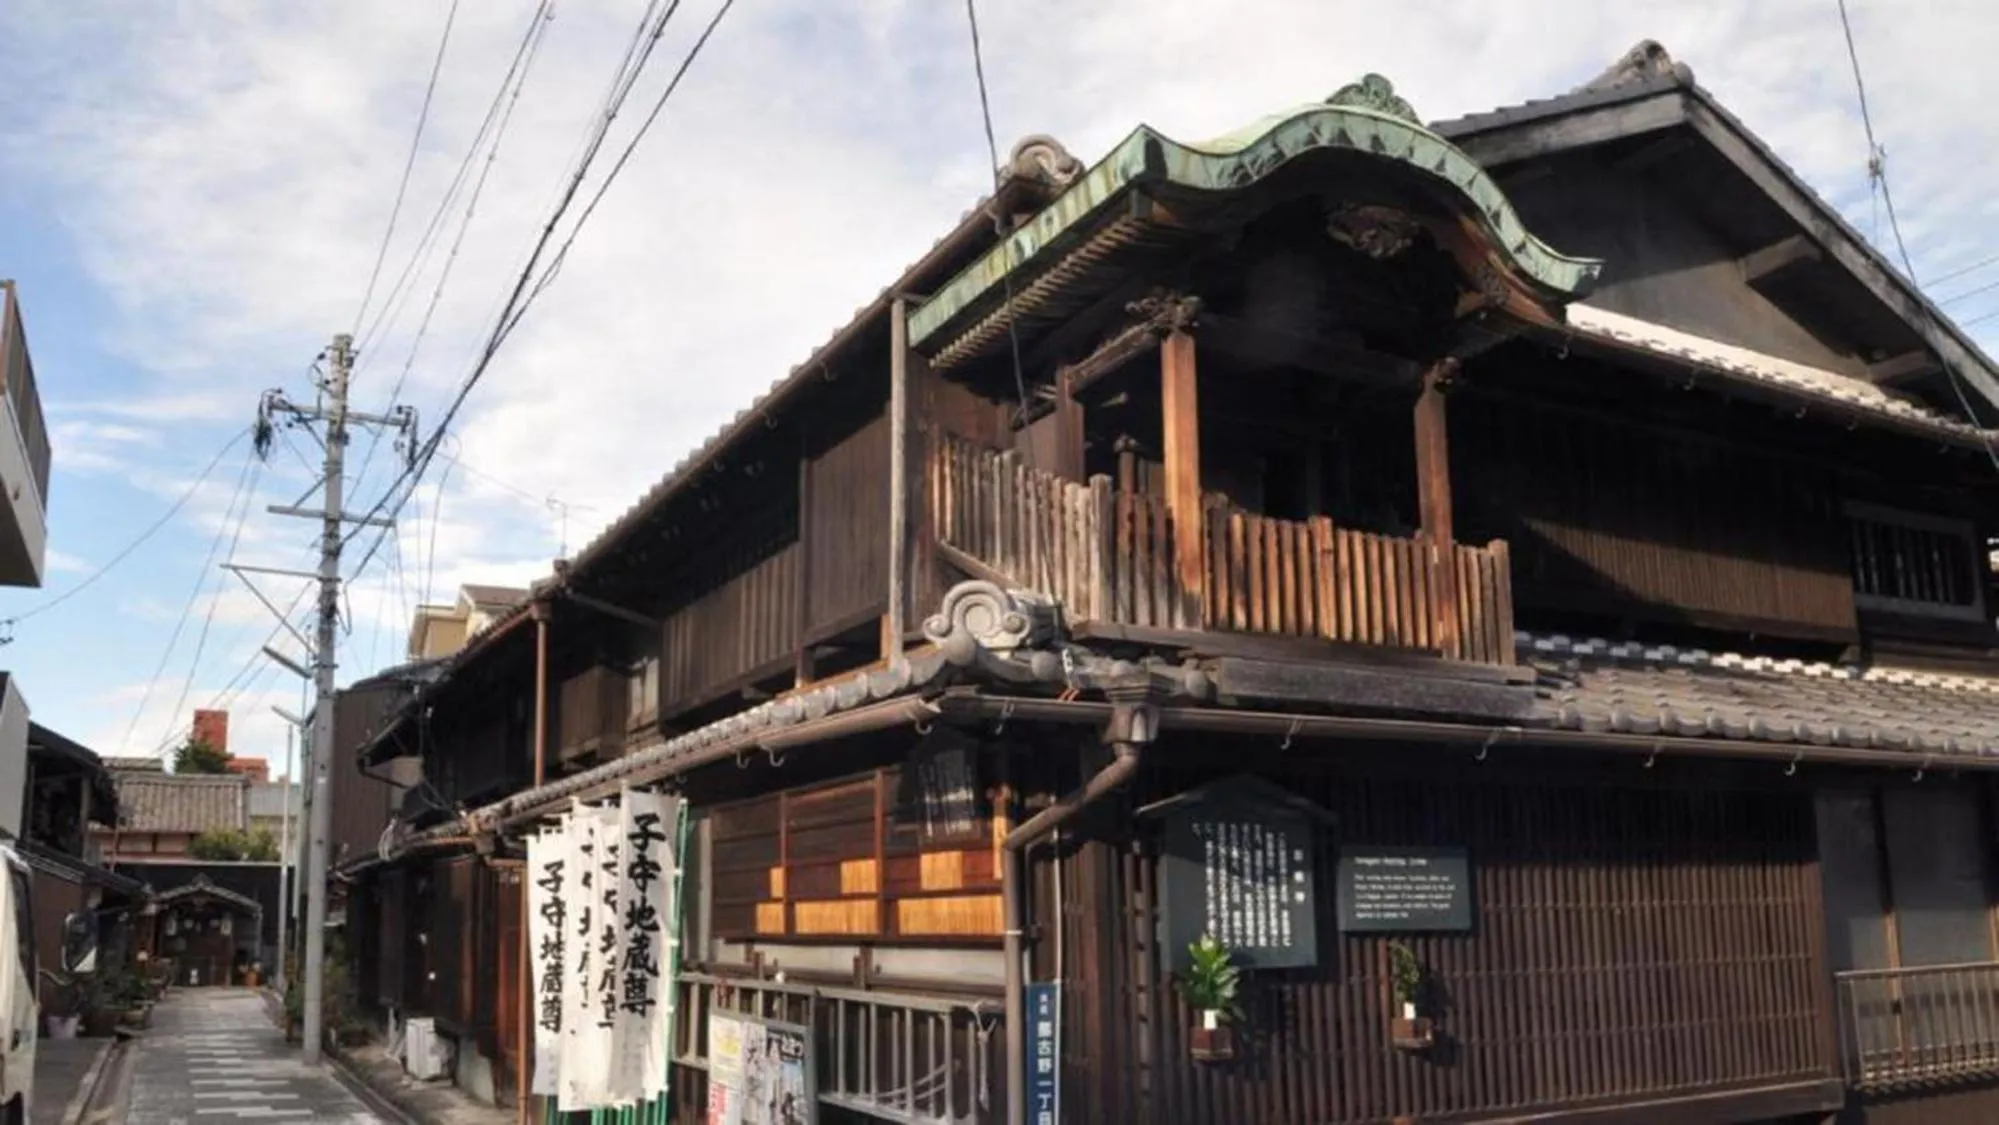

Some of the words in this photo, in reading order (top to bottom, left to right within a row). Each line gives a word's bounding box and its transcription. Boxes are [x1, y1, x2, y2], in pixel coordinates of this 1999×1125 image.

[620, 812, 667, 1018] 子守地蔵尊
